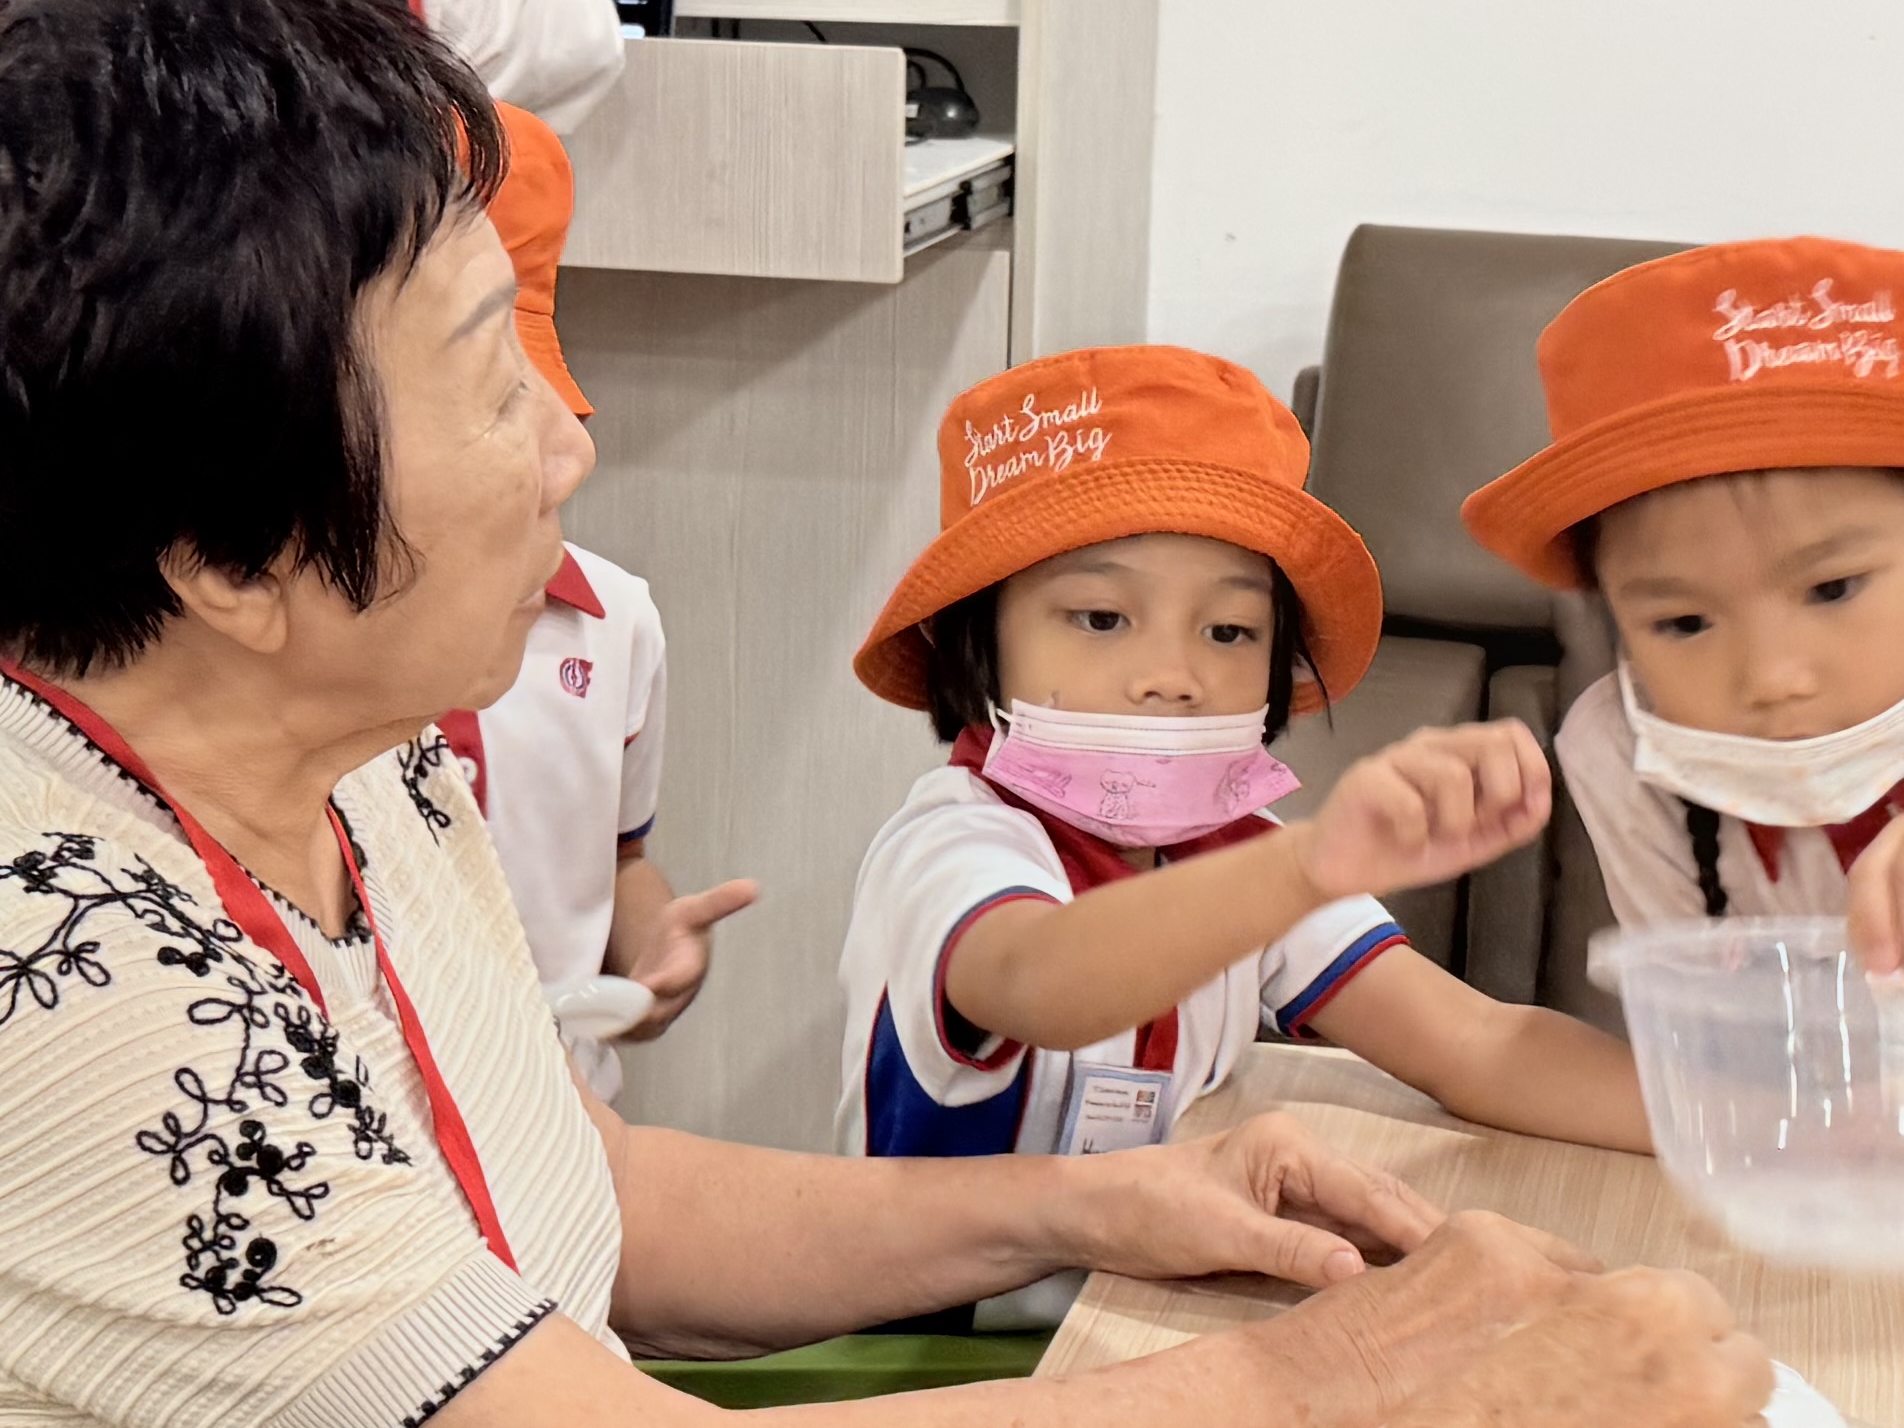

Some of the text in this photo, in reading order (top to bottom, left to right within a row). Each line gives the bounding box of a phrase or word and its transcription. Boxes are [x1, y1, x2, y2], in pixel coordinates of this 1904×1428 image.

[1807, 277, 1894, 330] Small
[1724, 329, 1901, 381] Dream Big
[964, 386, 1103, 468] Start Small
[969, 427, 1113, 508] Dream Big
